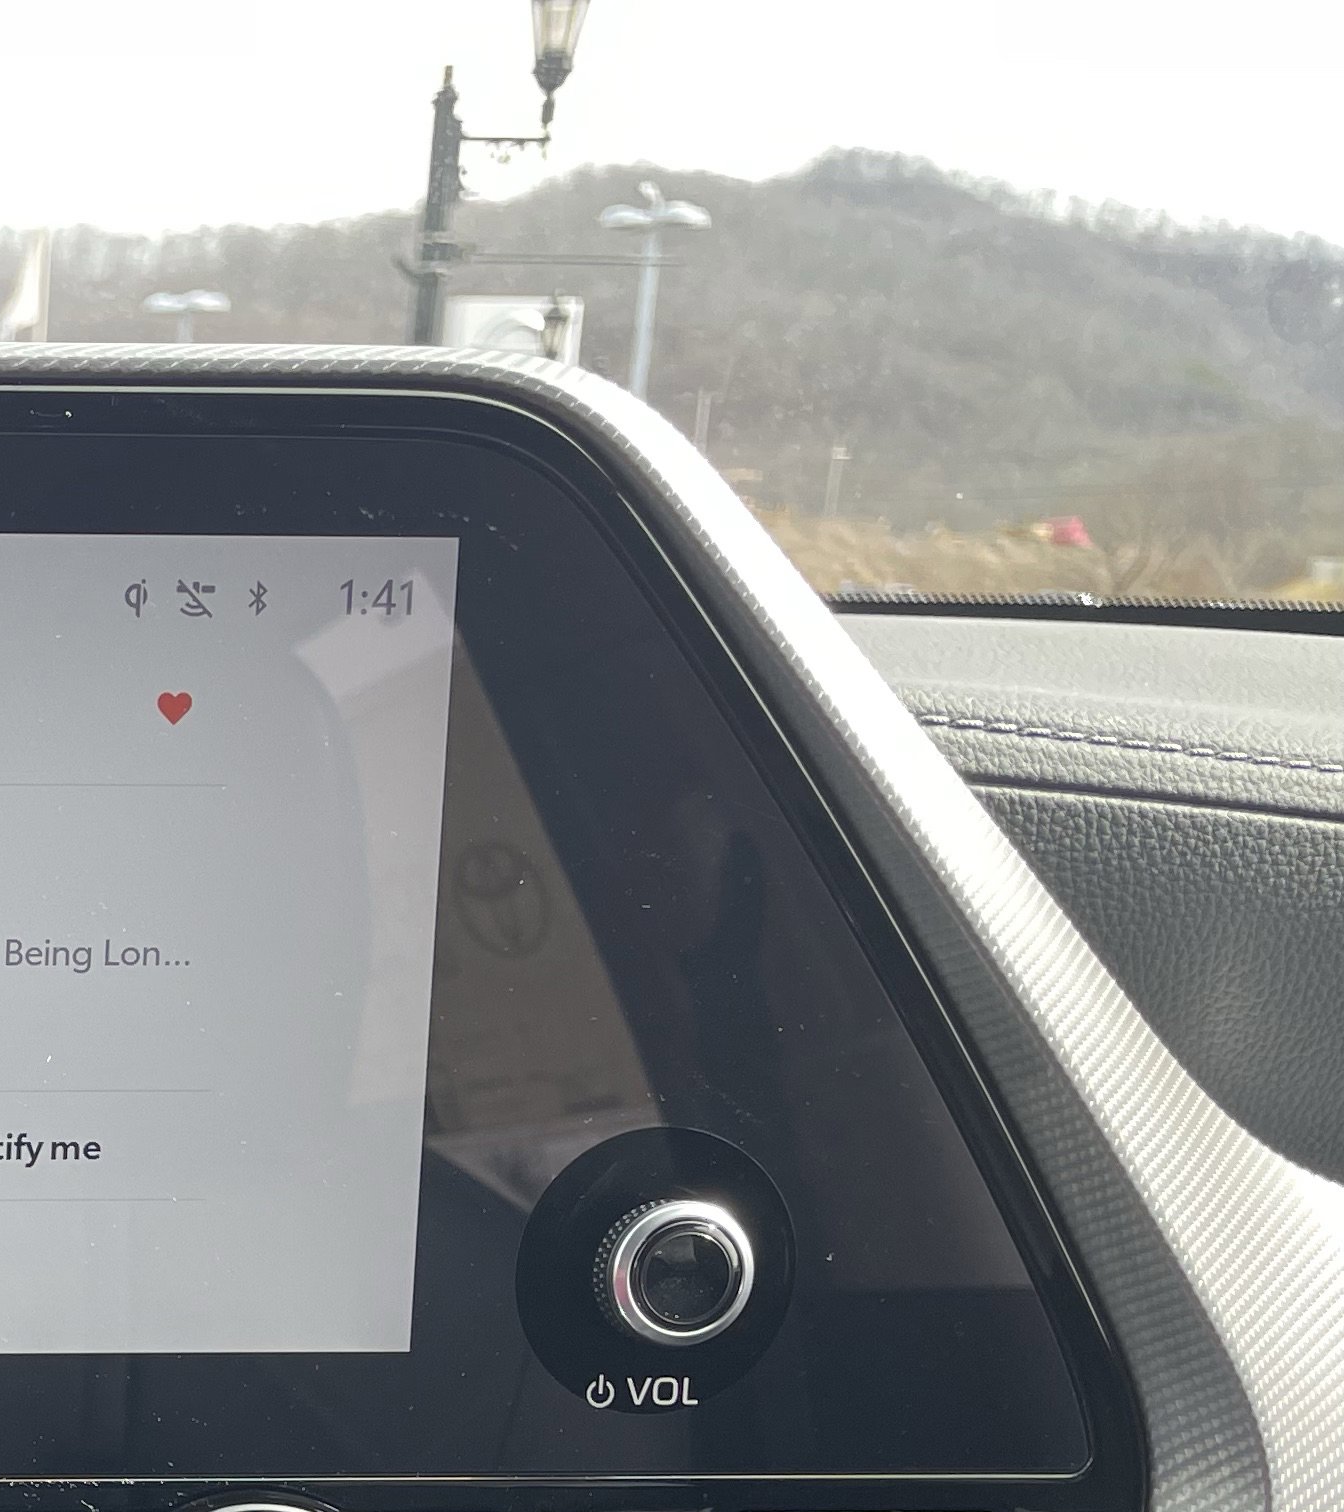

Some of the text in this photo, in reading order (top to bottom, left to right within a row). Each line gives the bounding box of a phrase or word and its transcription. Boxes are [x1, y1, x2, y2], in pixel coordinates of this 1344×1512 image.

[340, 579, 414, 616] 1:41
[6, 939, 92, 975] Being
[103, 940, 191, 968] Lon...
[51, 1140, 103, 1162] me
[627, 1376, 699, 1406] VOL
